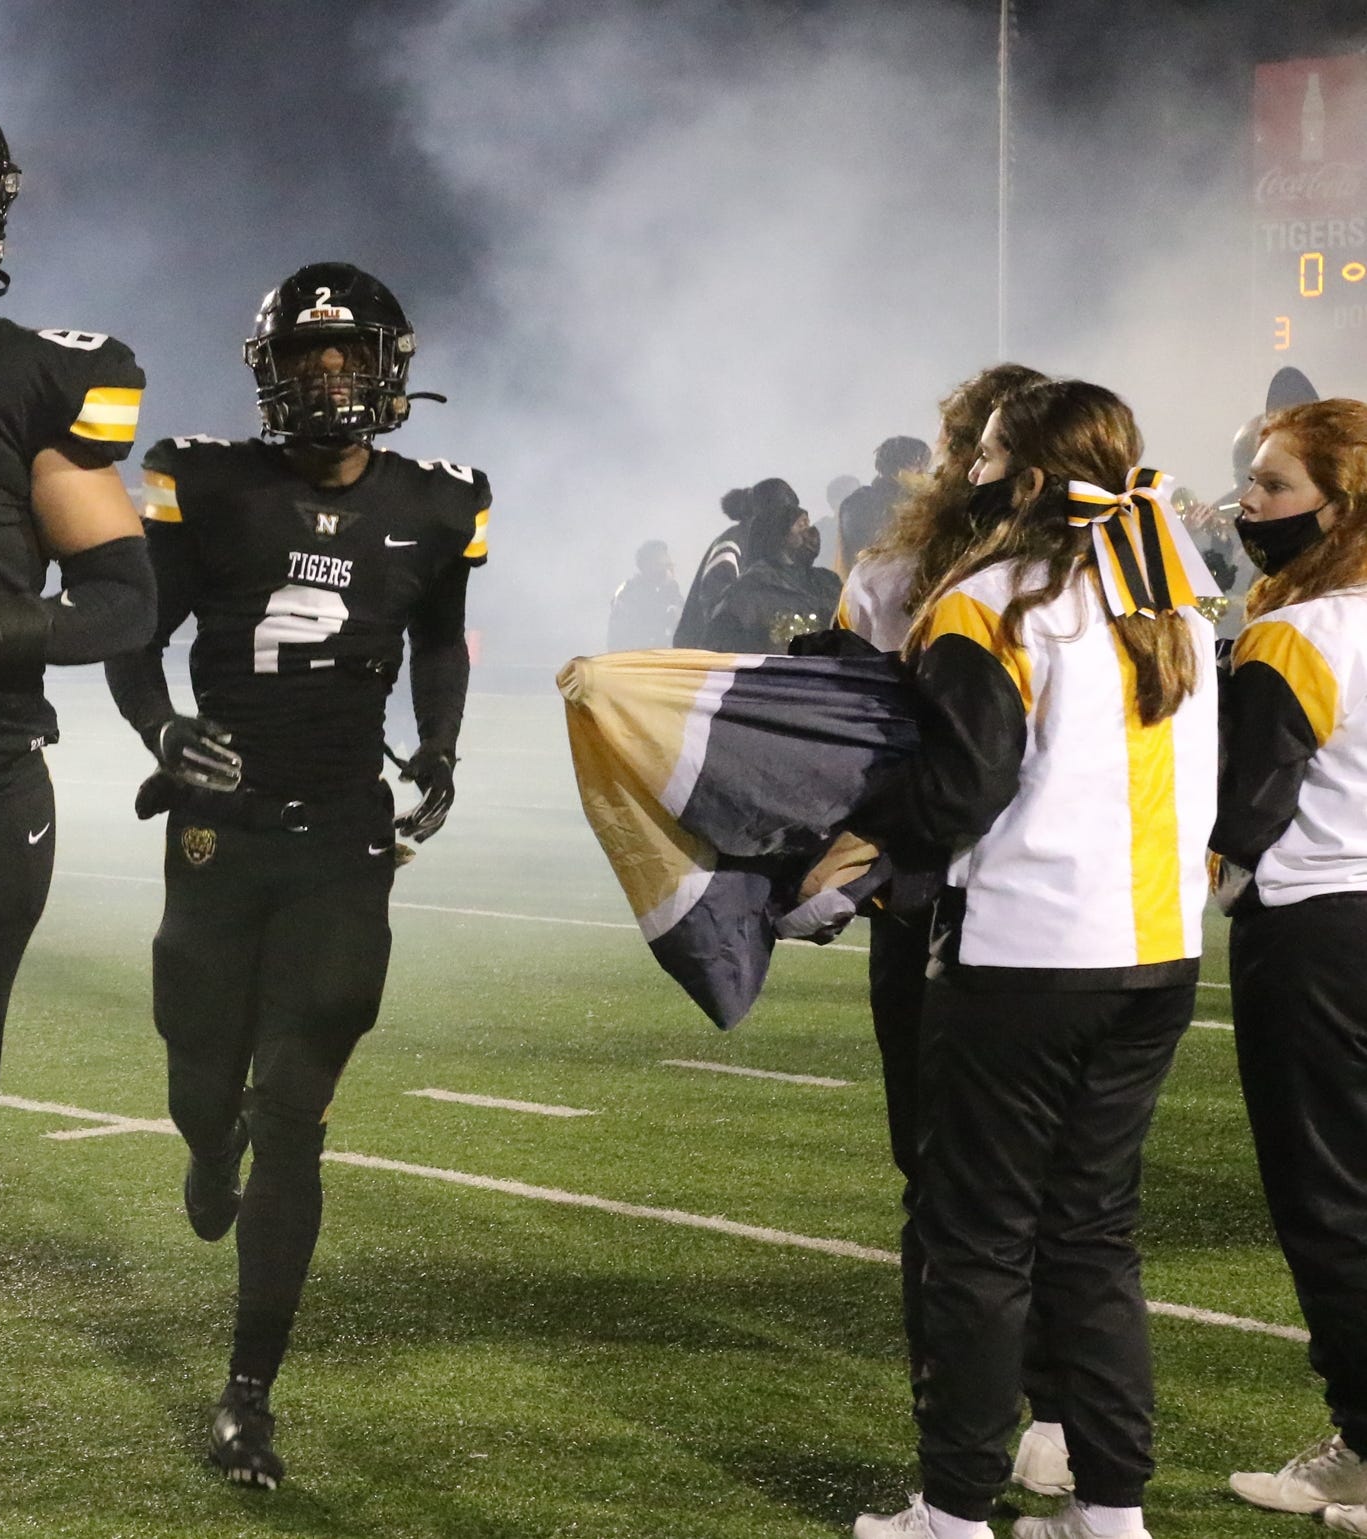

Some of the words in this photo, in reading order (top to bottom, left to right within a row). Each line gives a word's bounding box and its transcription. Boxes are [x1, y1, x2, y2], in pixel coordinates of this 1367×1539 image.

[1261, 217, 1366, 252] TIGERS
[1300, 252, 1324, 297] 0
[315, 286, 332, 308] 2
[315, 513, 339, 536] N
[287, 551, 353, 588] TIGERS
[253, 583, 350, 674] 2
